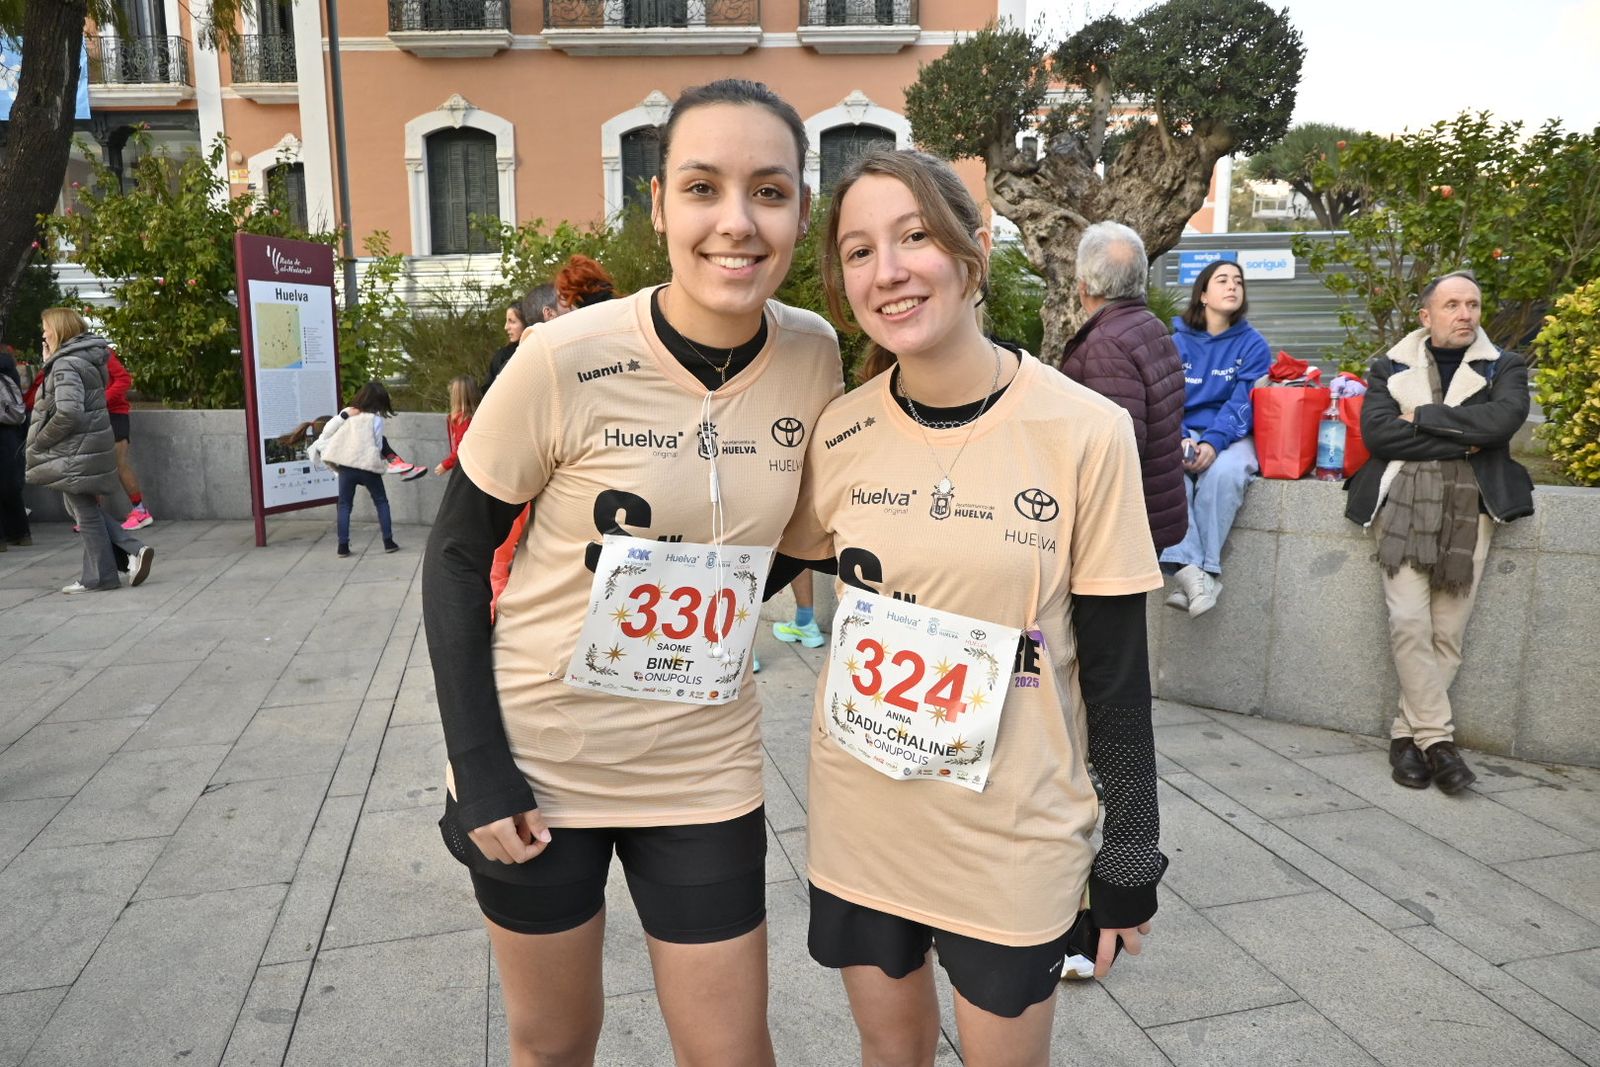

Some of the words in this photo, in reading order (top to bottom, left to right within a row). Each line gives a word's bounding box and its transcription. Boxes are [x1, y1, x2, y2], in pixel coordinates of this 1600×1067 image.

[275, 288, 309, 302] Huelva
[577, 362, 624, 383] luanvi
[604, 429, 678, 449] Huelva
[825, 422, 862, 449] luanvi
[722, 446, 757, 455] HUELVA
[851, 487, 911, 506] Huelva
[954, 509, 993, 521] HUELVA
[665, 553, 698, 564] Huelva
[620, 583, 737, 643] 330
[886, 611, 919, 627] Huelva
[656, 642, 692, 654] SAOME
[646, 657, 694, 672] BINET
[644, 672, 703, 686] ONUPOLIS
[851, 638, 969, 723] 324
[1014, 676, 1040, 688] 2025
[885, 710, 912, 726] ANNA
[846, 710, 957, 757] DADU-CHALINE
[873, 738, 929, 766] ONUPOLIS
